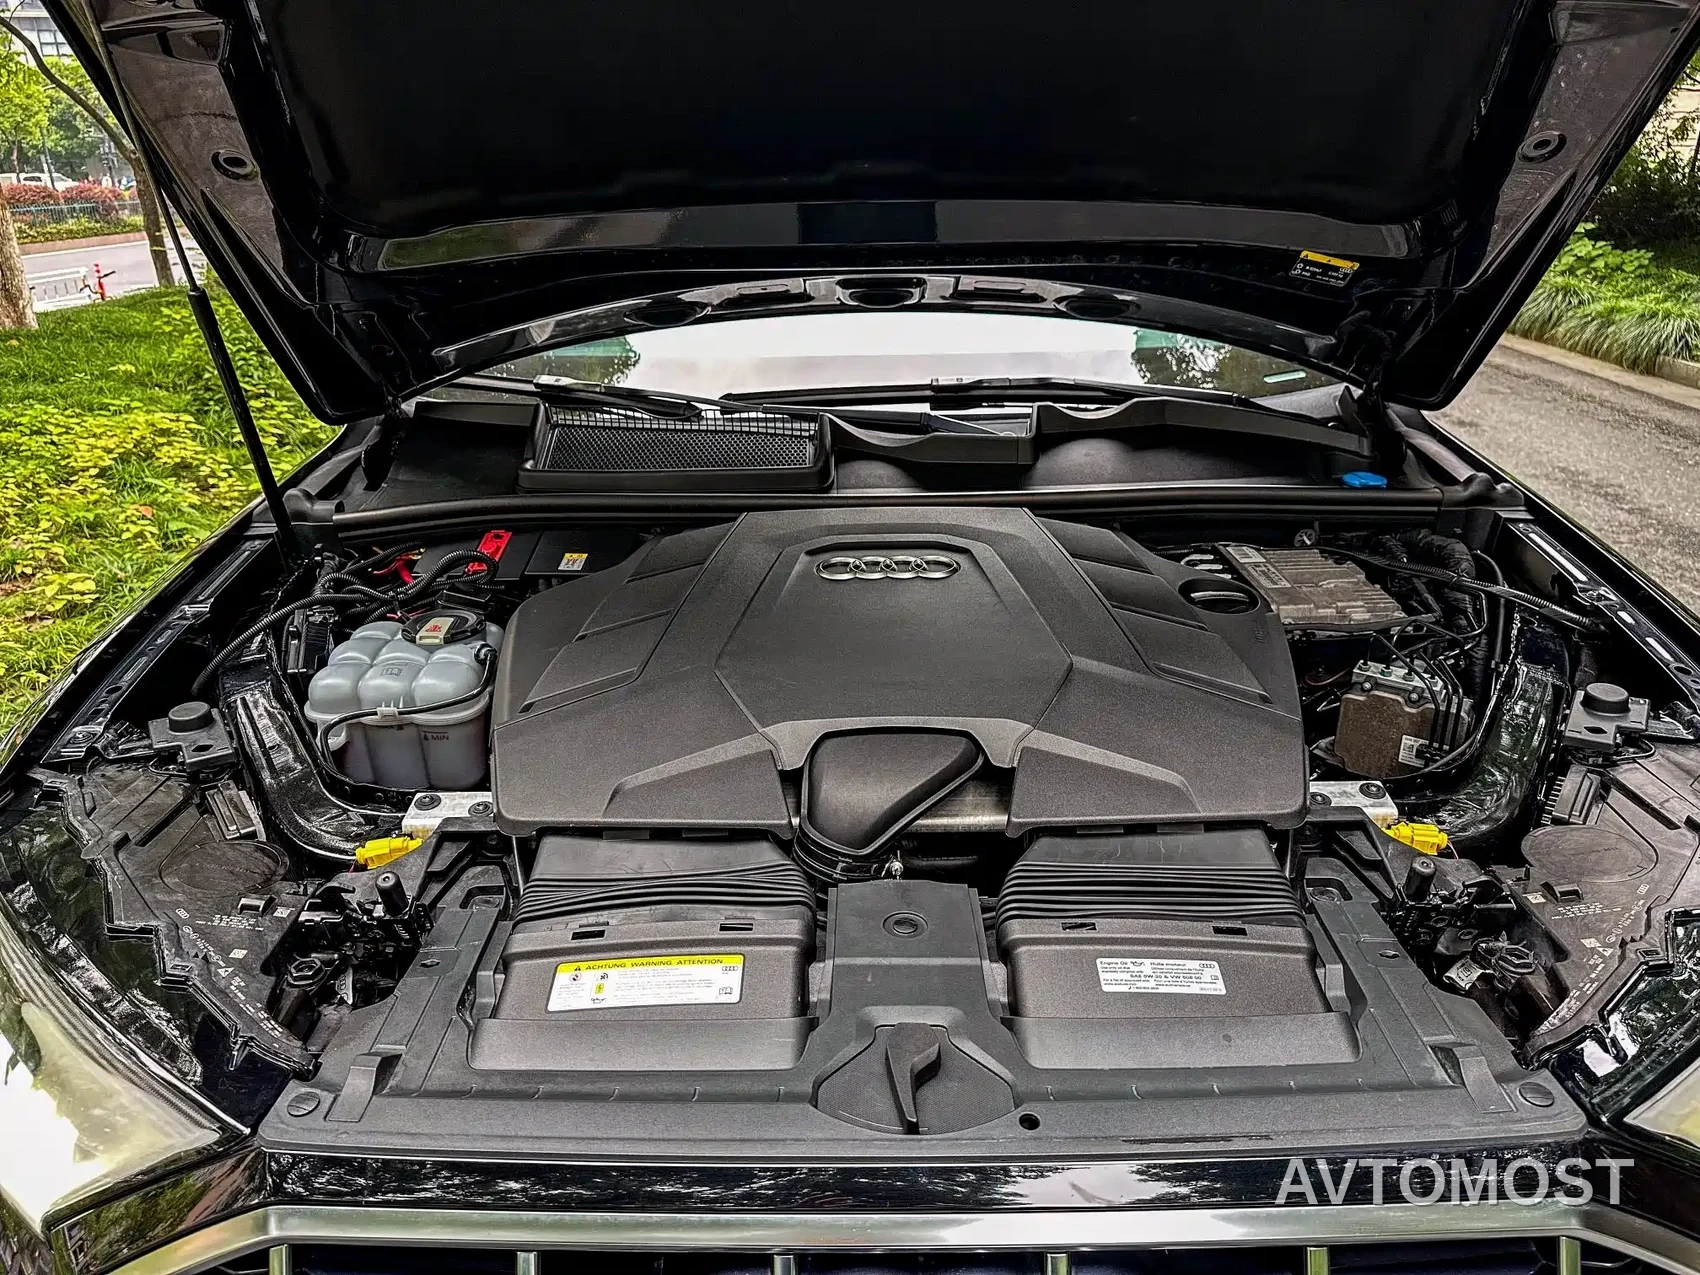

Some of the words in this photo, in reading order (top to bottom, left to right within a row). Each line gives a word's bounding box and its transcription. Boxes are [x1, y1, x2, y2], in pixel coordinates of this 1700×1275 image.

[585, 962, 626, 971] ACHTUNG
[631, 960, 672, 968] WARNING
[676, 958, 723, 966] ATTENTION
